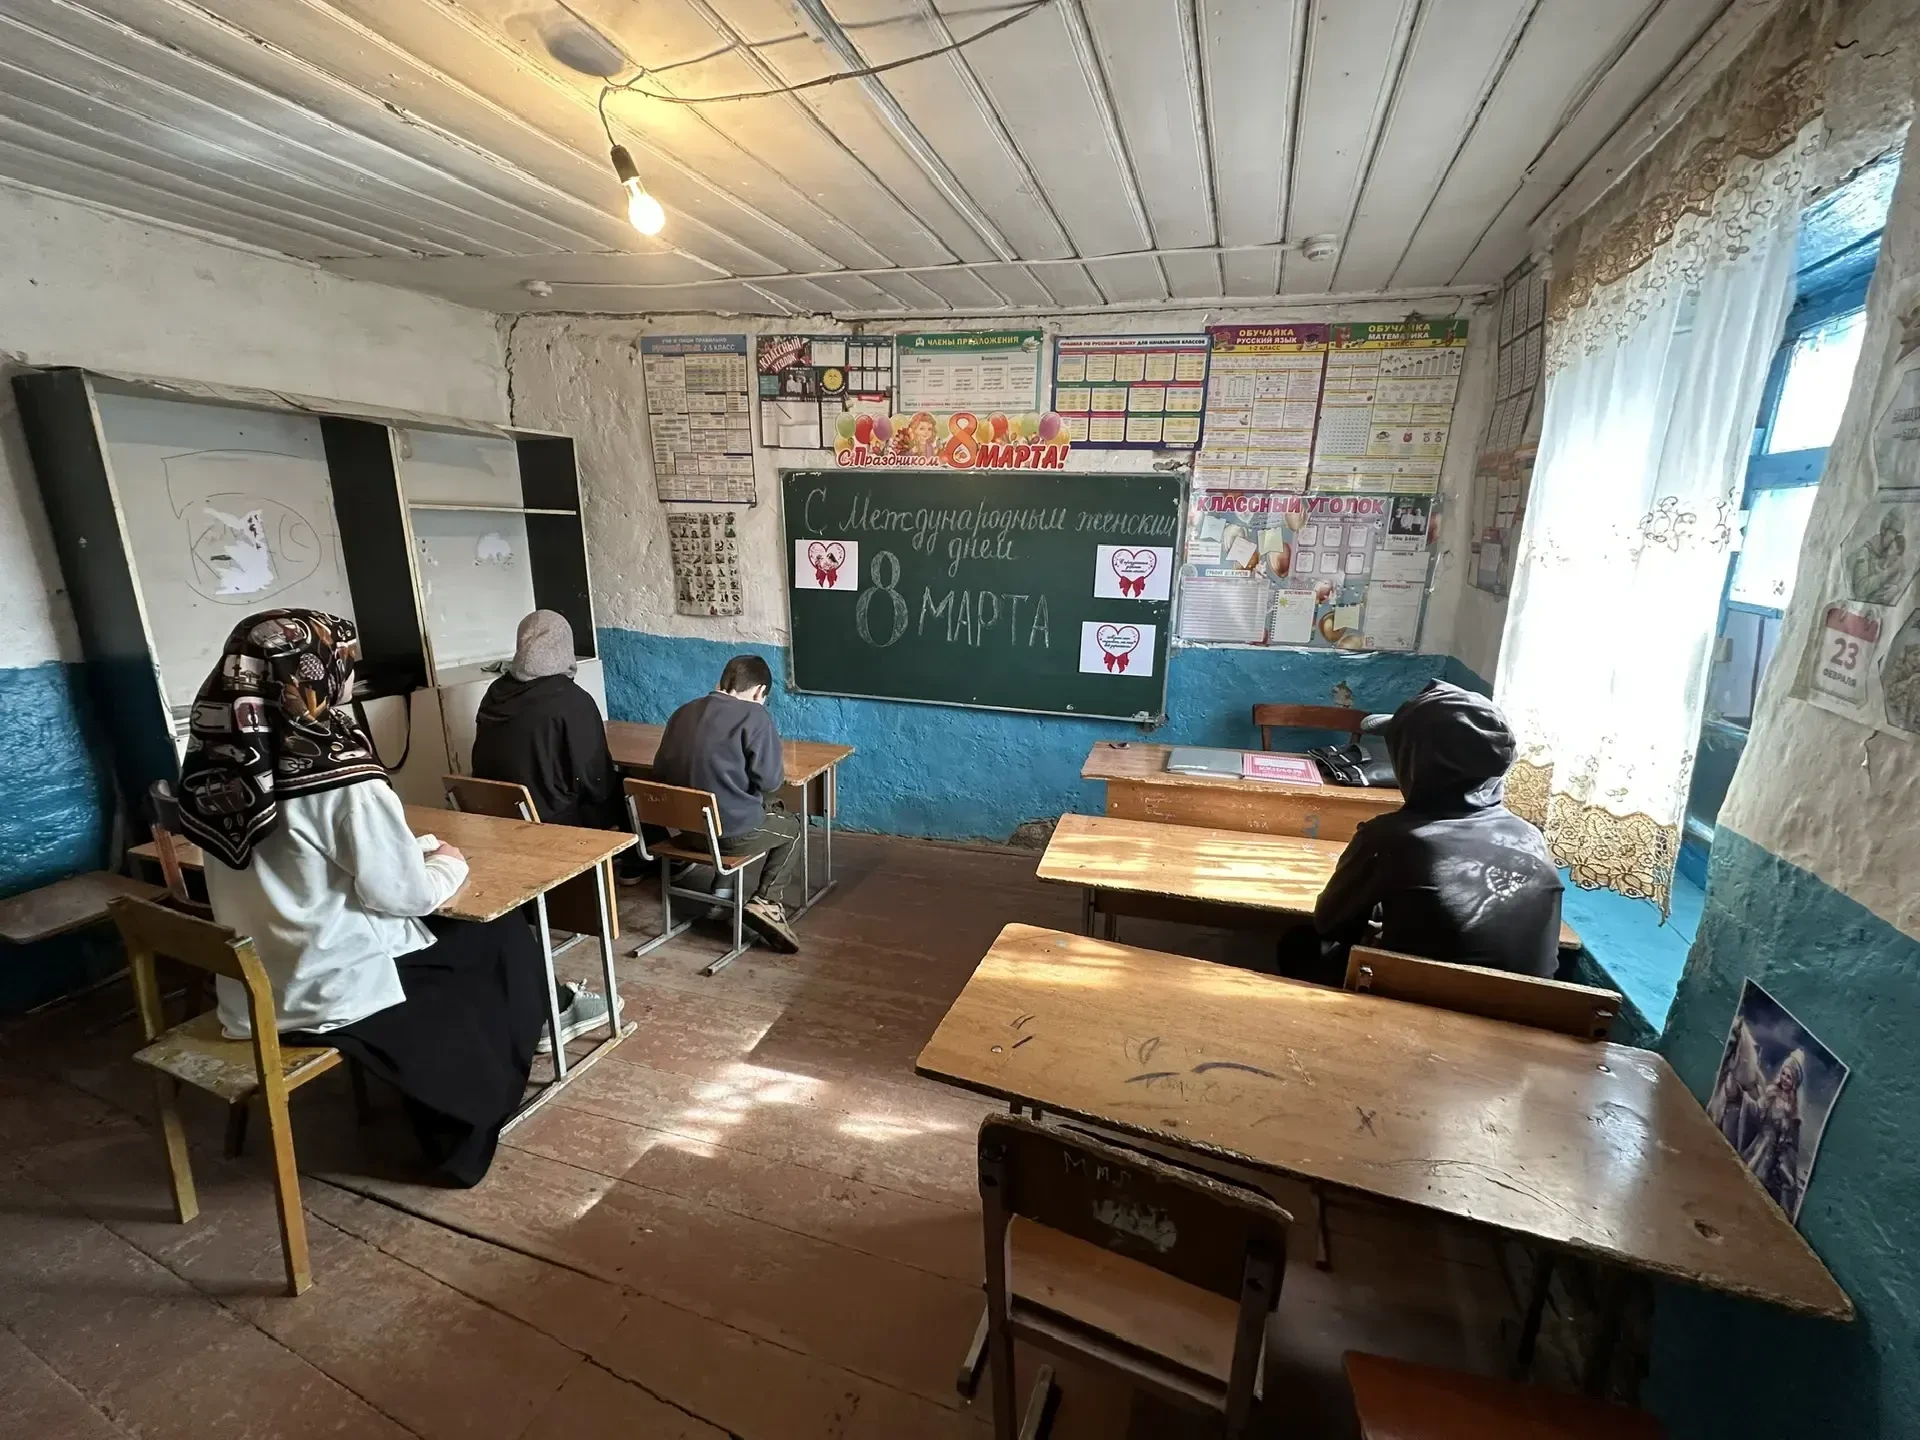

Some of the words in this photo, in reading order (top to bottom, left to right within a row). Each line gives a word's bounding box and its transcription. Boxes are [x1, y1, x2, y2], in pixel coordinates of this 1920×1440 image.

[927, 338, 955, 346] ЧЛЕНЫ
[957, 335, 1019, 346] ПРЕДЛОЖЕНИЯ
[1236, 337, 1273, 345] РУССКИЙ
[1275, 336, 1297, 344] ЯЗЫК
[1239, 328, 1294, 337] ОБУЧАЙКА
[976, 445, 1069, 469] МАРТА!
[805, 487, 828, 534] С
[1197, 496, 1300, 513] КЛАССНЫЙ
[1308, 497, 1384, 515] УГОЛОК
[856, 550, 908, 648] 8
[918, 586, 1050, 648] МАРТА
[1830, 637, 1859, 670] 23
[1822, 667, 1857, 688] ФЕВРАЛЯ
